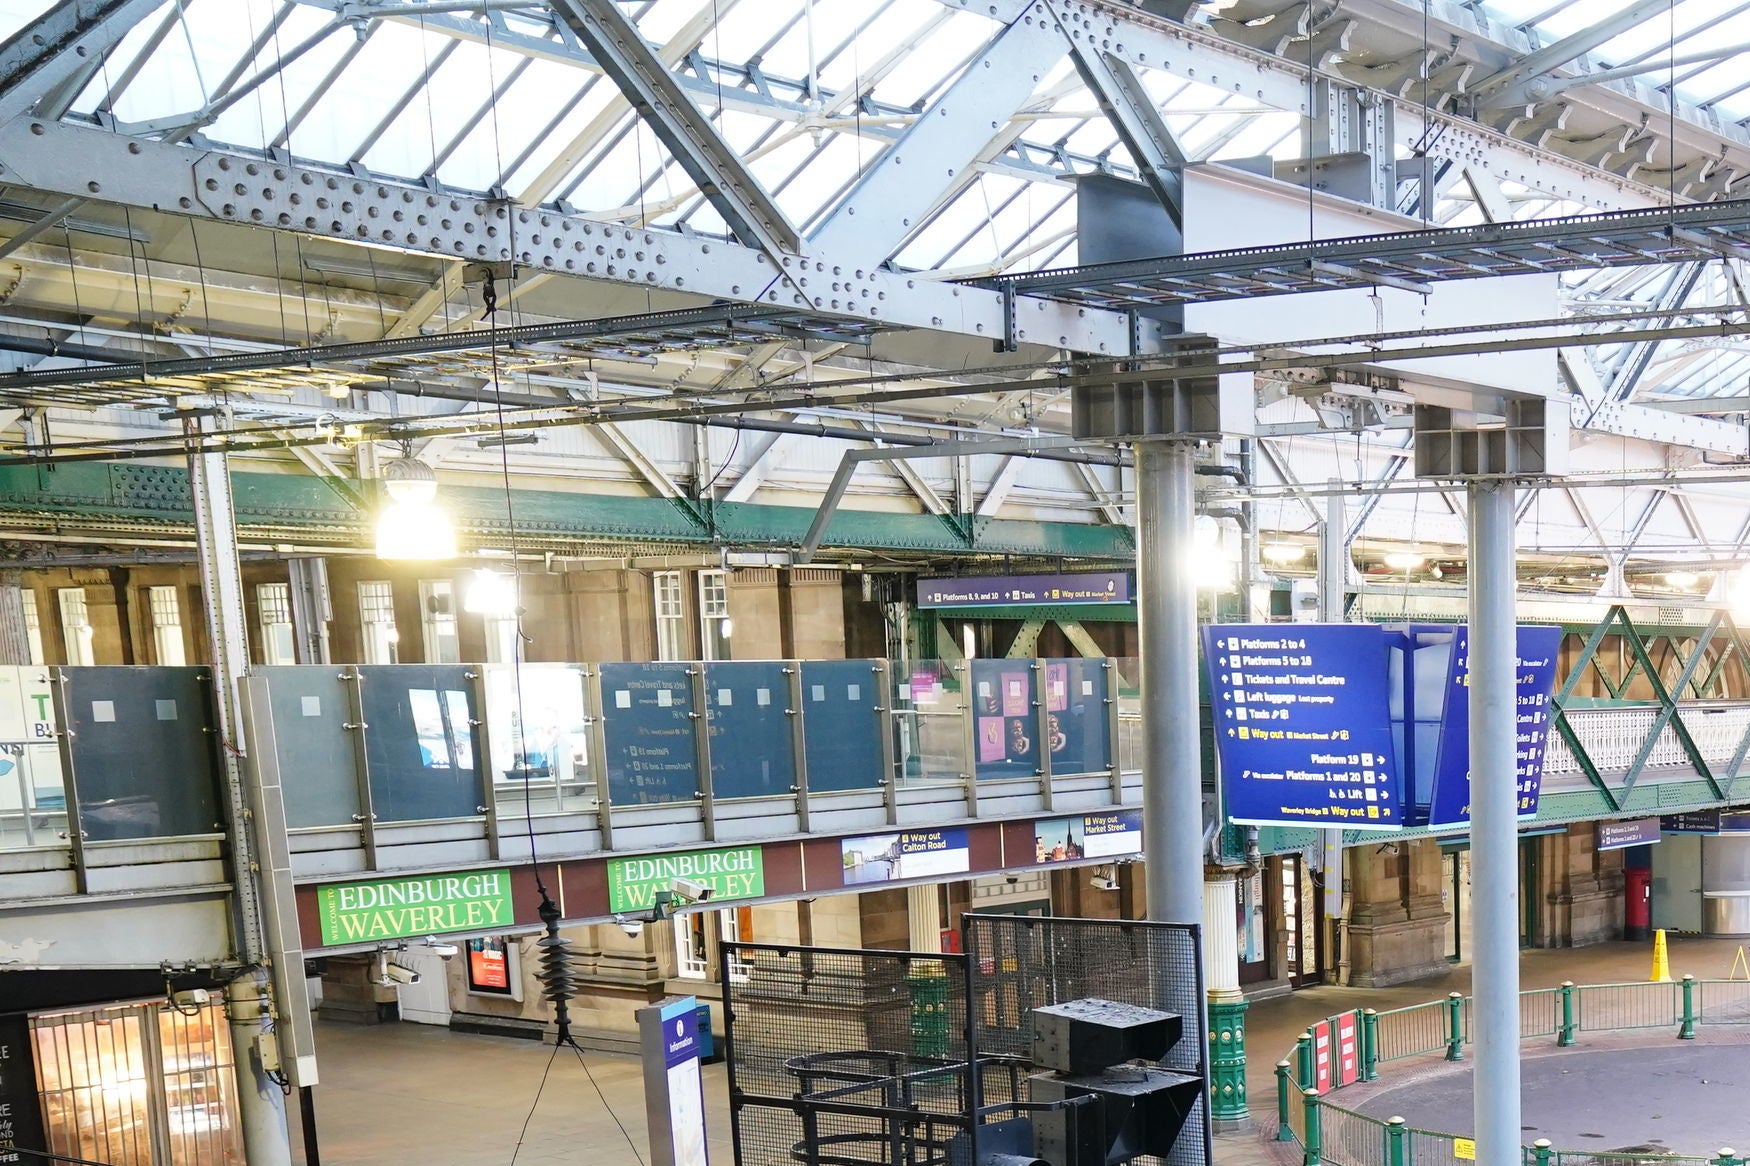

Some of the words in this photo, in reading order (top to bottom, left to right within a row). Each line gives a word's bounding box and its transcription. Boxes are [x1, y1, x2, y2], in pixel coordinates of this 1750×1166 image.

[968, 593, 974, 601] 8,
[974, 592, 980, 601] 9,
[980, 592, 990, 600] and
[991, 592, 999, 600] 10
[1021, 591, 1036, 600] Taxis
[1062, 590, 1074, 599] Way
[1074, 590, 1086, 598] out
[1240, 639, 1280, 650] Platforms
[1280, 640, 1287, 649] 2
[1288, 640, 1298, 649] to
[1298, 639, 1306, 649] 4
[1242, 656, 1282, 666] Platforms
[1282, 656, 1289, 666] 5
[1289, 656, 1300, 666] to
[1300, 656, 1312, 666] 18
[1245, 674, 1274, 685] Tickets
[1274, 674, 1290, 685] and
[1290, 674, 1315, 685] Travel
[1316, 675, 1345, 686] Centre
[1246, 692, 1264, 702] Left
[1264, 692, 1296, 704] luggage
[1518, 696, 1522, 705] 5
[1522, 696, 1528, 704] to
[1528, 695, 1536, 704] 18
[1248, 709, 1270, 720] Taxis
[1517, 713, 1533, 723] Centre
[1251, 729, 1269, 740] Way
[1270, 730, 1284, 739] out
[1310, 754, 1347, 765] Platform
[1348, 754, 1359, 765] 19
[1286, 770, 1325, 782] Platforms
[1326, 771, 1332, 781] 1
[1332, 772, 1348, 782] and
[1349, 772, 1361, 782] 20
[1348, 788, 1363, 800] Lift
[1280, 806, 1304, 815] Waverley
[1304, 808, 1322, 816] Bridge
[1330, 806, 1350, 818] Way
[1350, 808, 1365, 817] out
[1091, 817, 1105, 826] Way
[1106, 816, 1118, 824] out
[1085, 825, 1107, 834] Market
[1107, 823, 1126, 832] Street
[910, 833, 924, 843] Way
[926, 832, 941, 841] out
[902, 842, 926, 853] Calton
[927, 840, 947, 850] Road
[615, 860, 622, 872] TO
[624, 850, 755, 882] EDINBURGH
[328, 887, 335, 902] TO
[338, 873, 501, 911] EDINBURGH
[616, 874, 624, 910] WELCOME
[328, 904, 339, 941] WELCOME
[339, 898, 504, 940] WAVERLEY
[669, 1036, 694, 1053] Information
